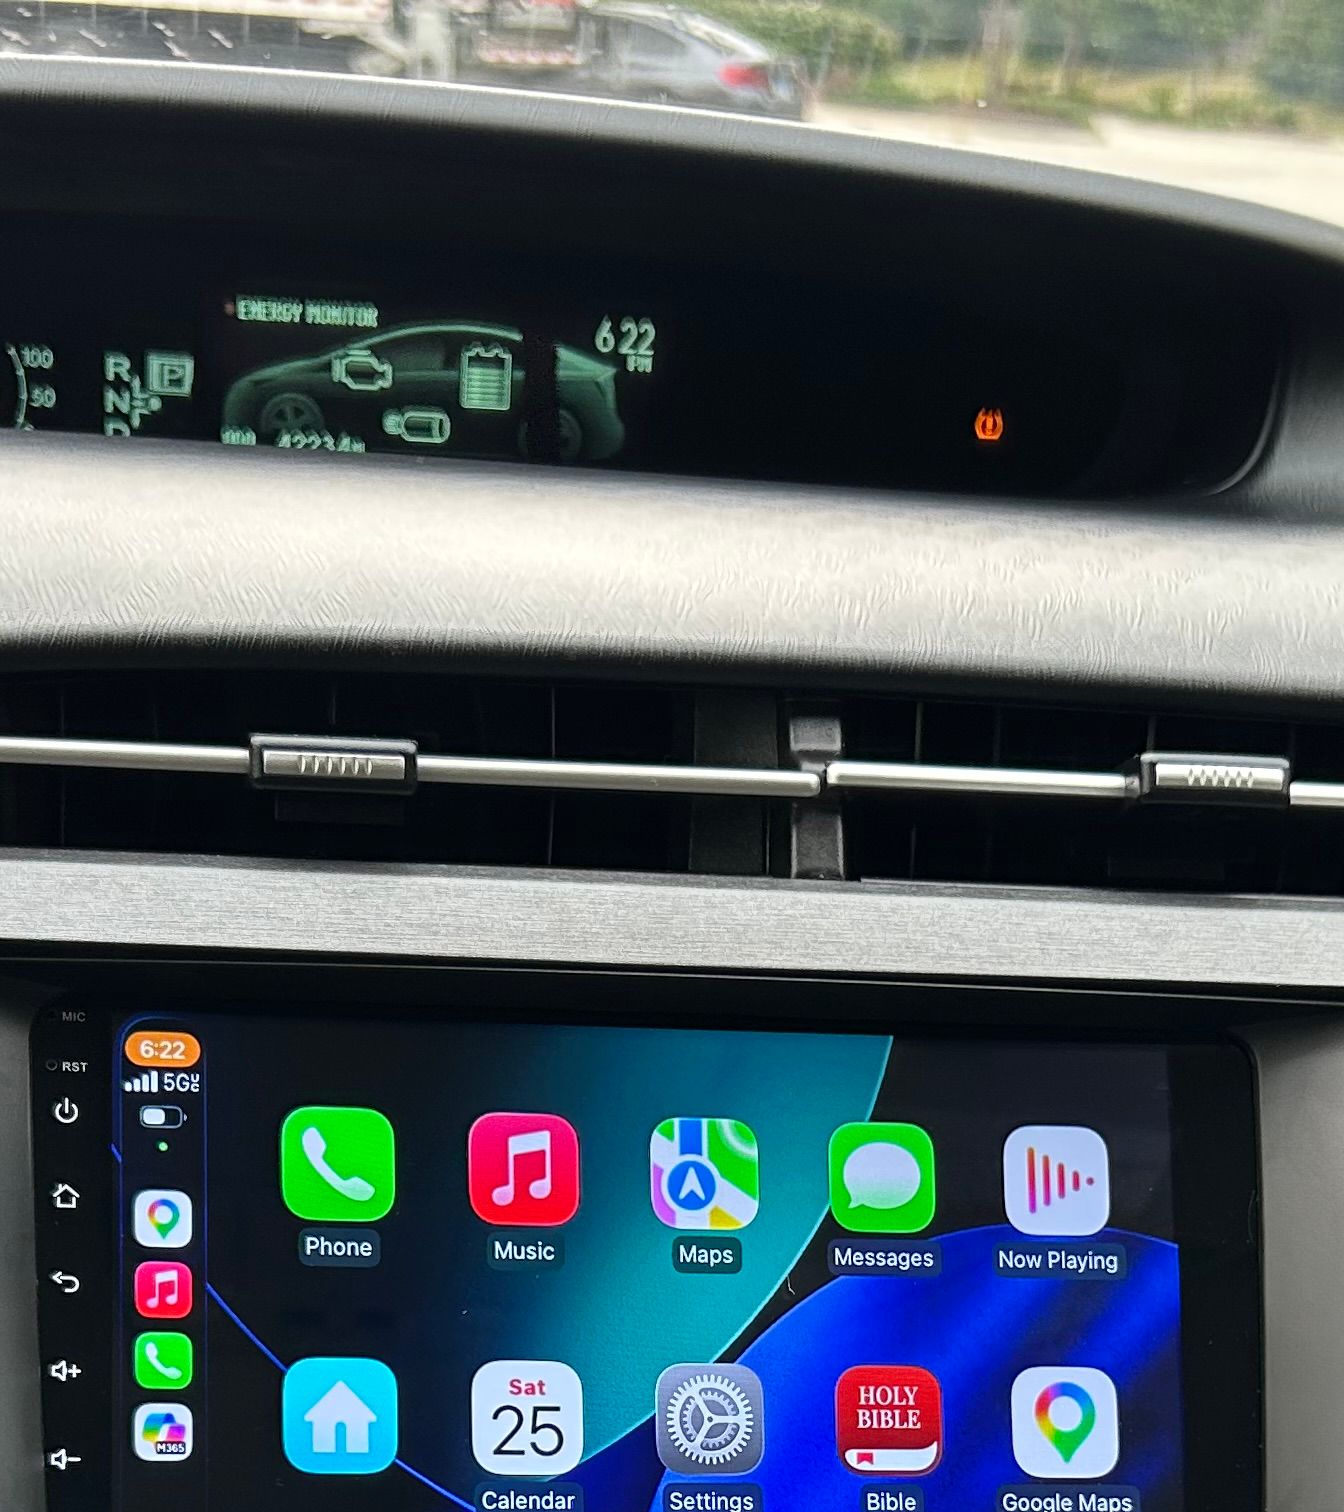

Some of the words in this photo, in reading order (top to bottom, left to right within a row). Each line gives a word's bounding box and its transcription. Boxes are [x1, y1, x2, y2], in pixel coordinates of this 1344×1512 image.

[236, 295, 303, 323] ENERGY
[304, 299, 378, 328] MONITOR
[19, 345, 54, 369] 100
[104, 351, 131, 381] R
[163, 364, 185, 388] P
[28, 385, 56, 408] 50
[104, 386, 131, 414] N
[62, 1011, 86, 1022] MIC
[140, 1040, 186, 1060] 6:22
[62, 1062, 88, 1073] RST
[305, 1236, 373, 1258] Phone
[494, 1241, 556, 1261] Music
[679, 1246, 734, 1266] Maps
[834, 1247, 935, 1269] Messages
[999, 1251, 1044, 1269] Now
[1048, 1252, 1118, 1275] Playing
[509, 1378, 546, 1397] Sat
[858, 1385, 920, 1406] HOLY
[856, 1409, 922, 1430] BIBLE
[492, 1404, 565, 1457] 25
[156, 1442, 185, 1454] M365
[482, 1491, 576, 1511] Calendar
[866, 1493, 917, 1512] Bible
